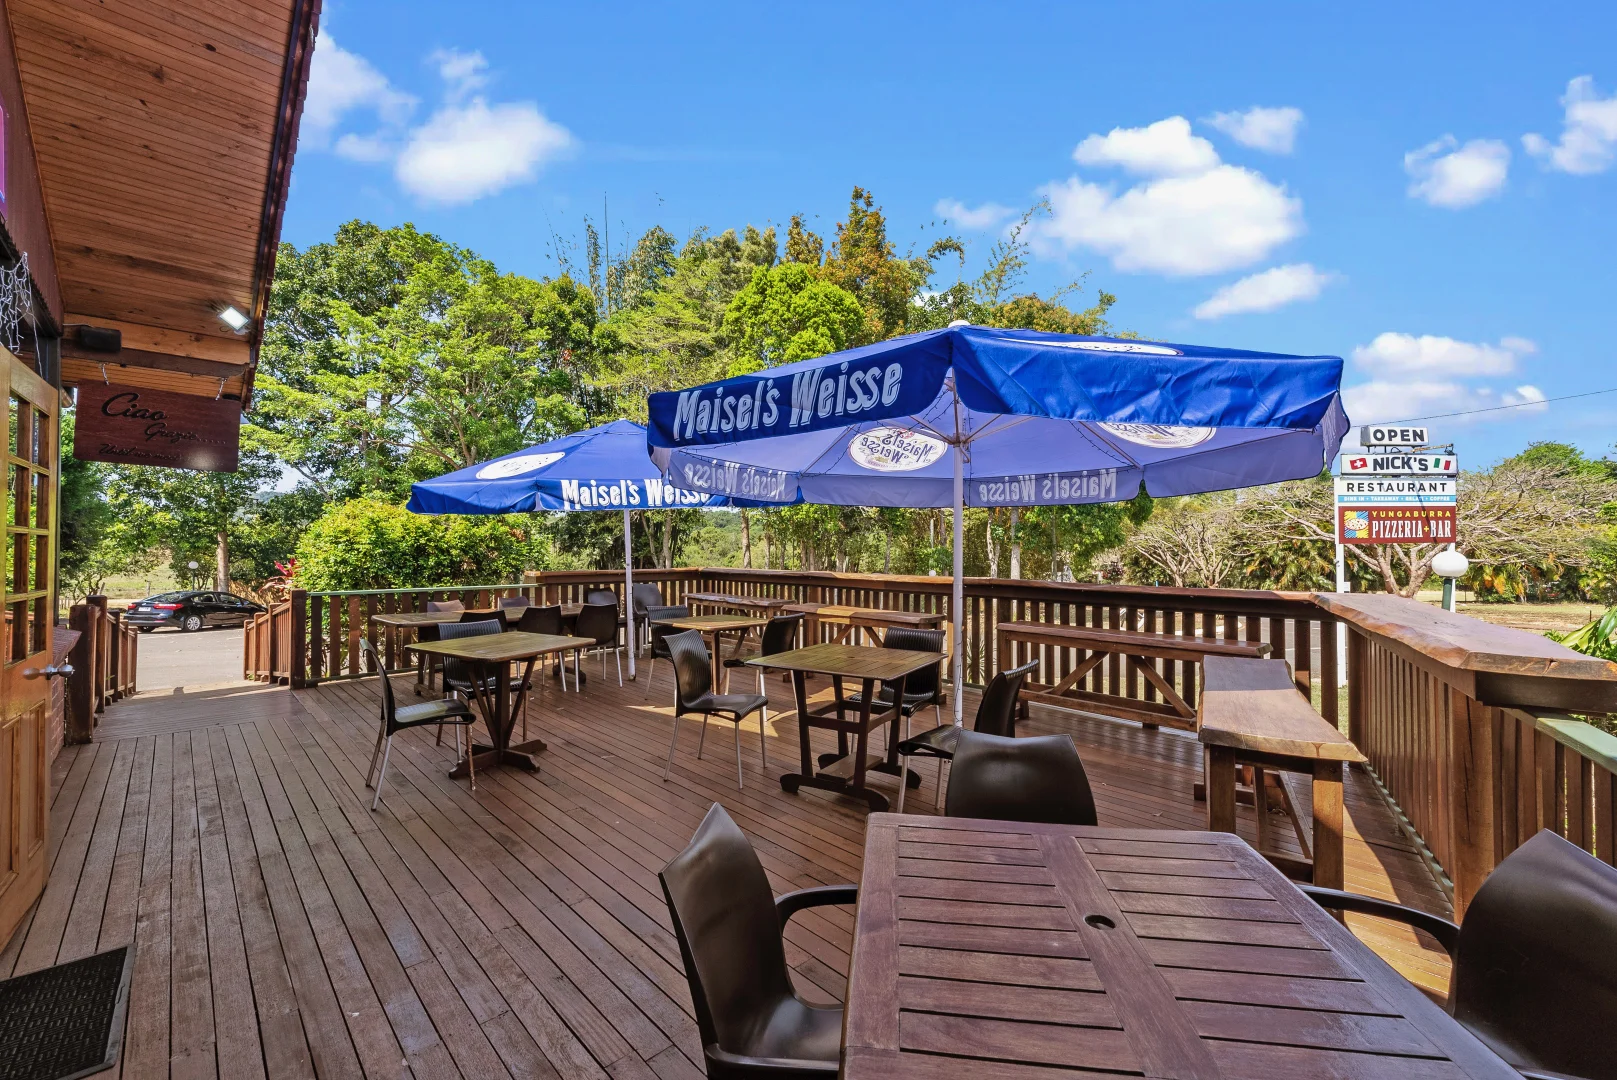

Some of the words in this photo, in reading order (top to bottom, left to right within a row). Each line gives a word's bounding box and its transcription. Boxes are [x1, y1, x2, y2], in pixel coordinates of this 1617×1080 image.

[101, 392, 167, 421] Ciao
[673, 379, 780, 441] Maisel's
[789, 361, 903, 428] Weisse
[1373, 429, 1425, 442] OPEN
[1373, 456, 1428, 471] NICK'S
[560, 479, 641, 510] Maisel's
[1346, 483, 1447, 493] RESTAURANT
[1372, 520, 1423, 538] PIZZERIA
[1430, 520, 1451, 538] BAR
